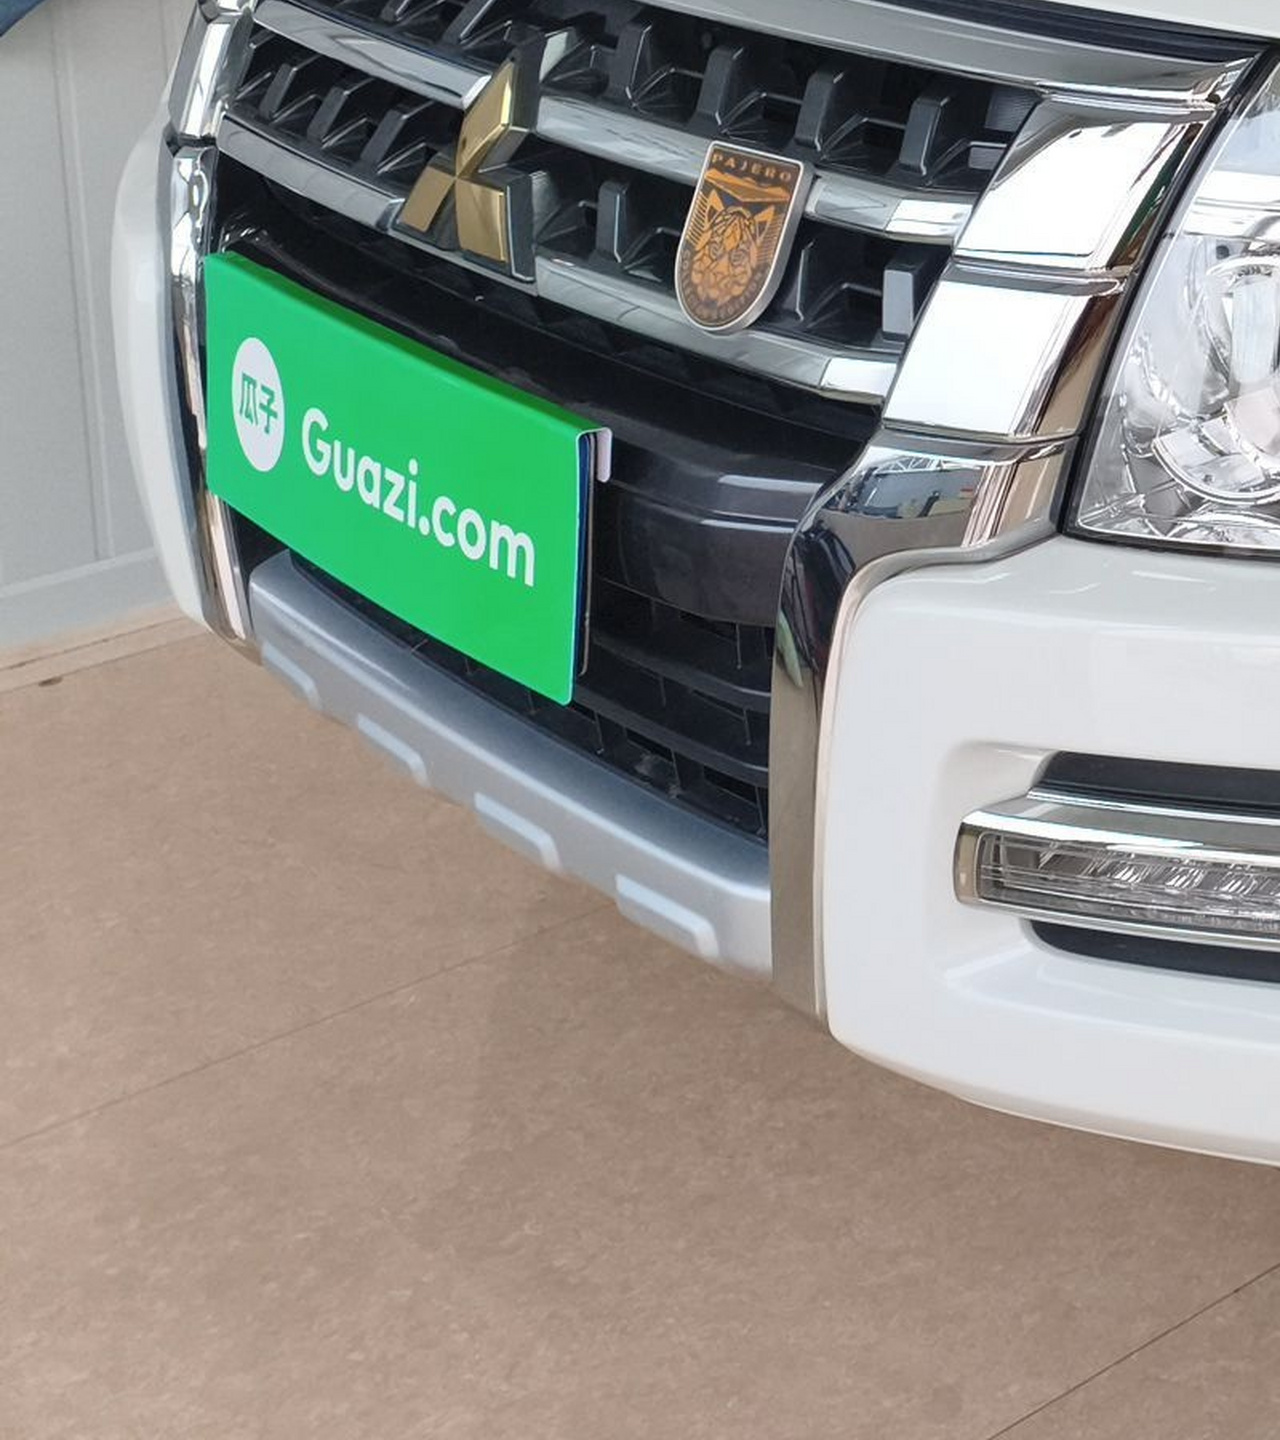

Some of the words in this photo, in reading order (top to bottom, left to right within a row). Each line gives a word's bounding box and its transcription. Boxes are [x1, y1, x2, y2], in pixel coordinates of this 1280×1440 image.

[710, 152, 793, 182] PAJERO
[238, 372, 279, 435] 瓜子
[301, 407, 537, 588] Guazi.com
